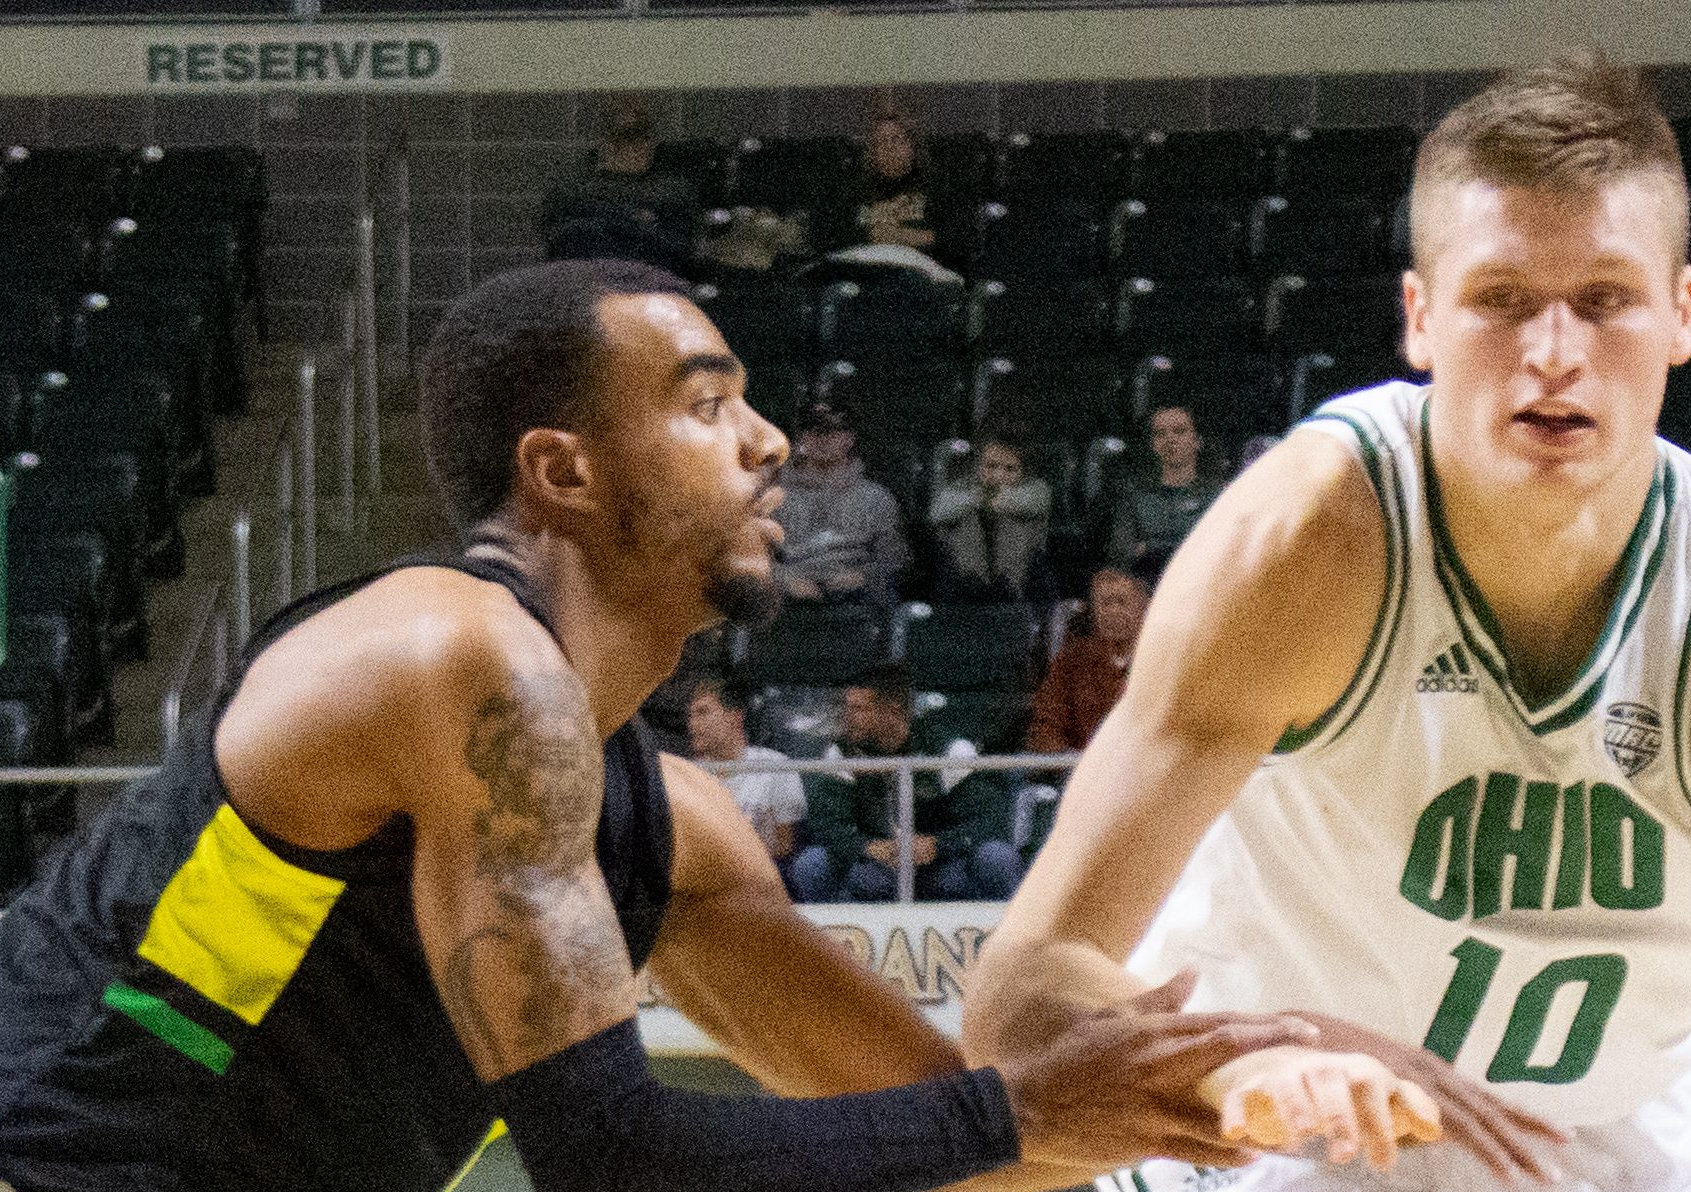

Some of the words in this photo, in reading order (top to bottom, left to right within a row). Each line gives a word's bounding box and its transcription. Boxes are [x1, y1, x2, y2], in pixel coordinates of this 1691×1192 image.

[146, 39, 442, 83] RESERVED
[1416, 678, 1479, 694] adidas
[1399, 771, 1666, 921] OHIO
[1422, 936, 1629, 1085] 10
